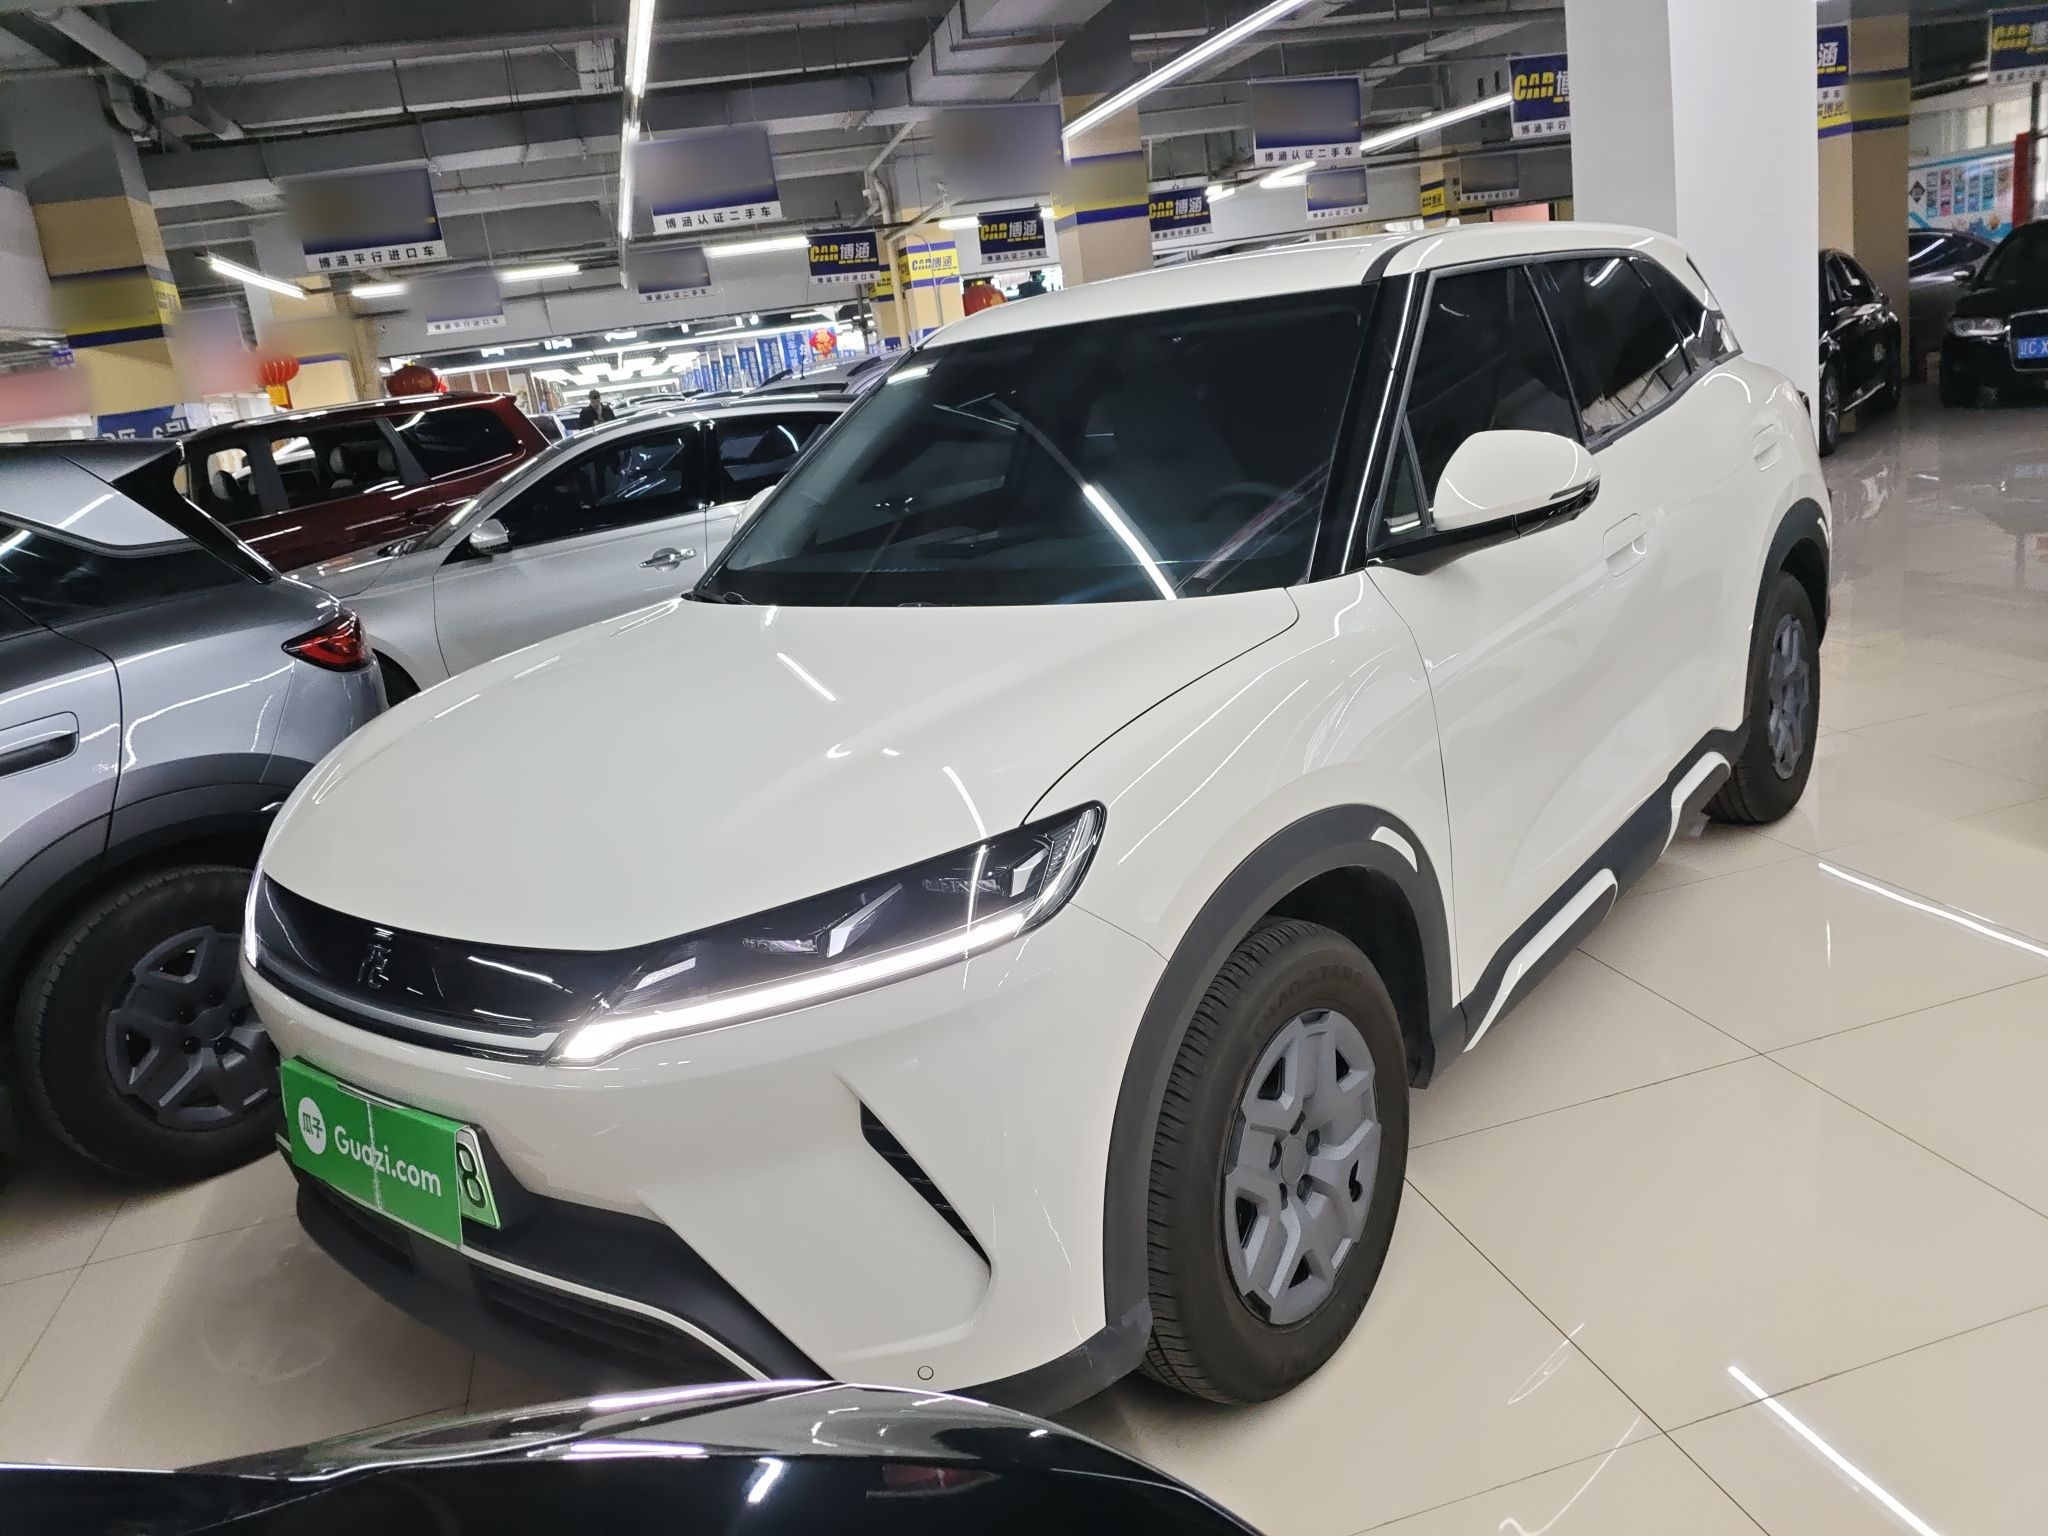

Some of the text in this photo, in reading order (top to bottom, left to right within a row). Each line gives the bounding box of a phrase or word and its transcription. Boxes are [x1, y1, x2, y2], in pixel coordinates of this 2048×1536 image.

[1264, 146, 1353, 162] 博涵认证二手车
[665, 206, 772, 230] 博涵认证二手车
[318, 246, 435, 269] 博涵平行进口车
[301, 1111, 323, 1139] 瓜子
[334, 1125, 442, 1197] Guazi.com
